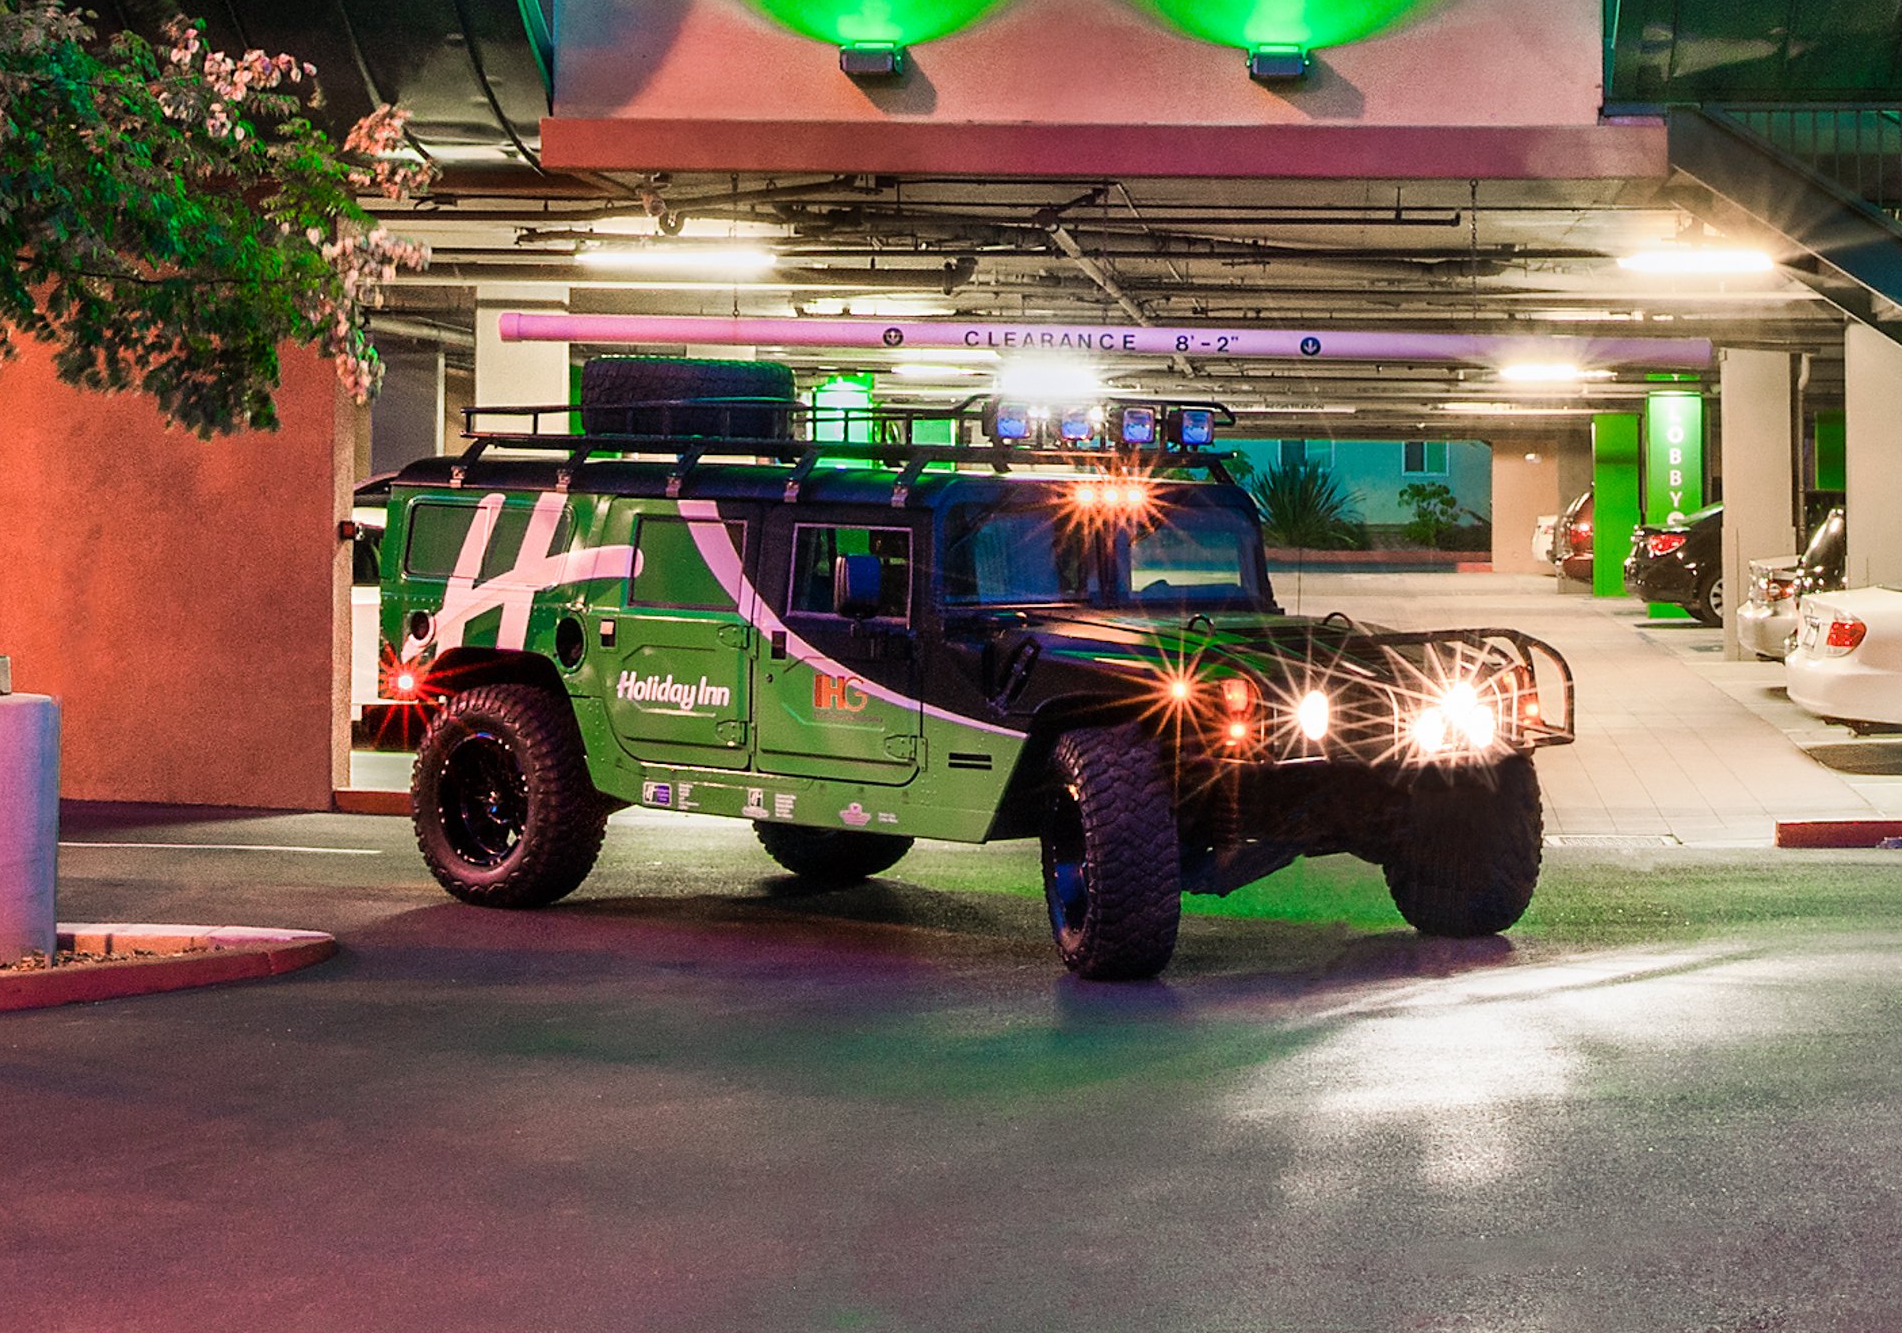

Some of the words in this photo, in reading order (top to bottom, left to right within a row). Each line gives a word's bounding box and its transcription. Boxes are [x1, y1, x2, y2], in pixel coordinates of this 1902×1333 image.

[964, 330, 1136, 351] CLEARANCE
[1666, 403, 1685, 508] LOBBY
[617, 670, 696, 711] Holiday
[697, 676, 730, 707] Inn
[813, 673, 869, 713] IHG
